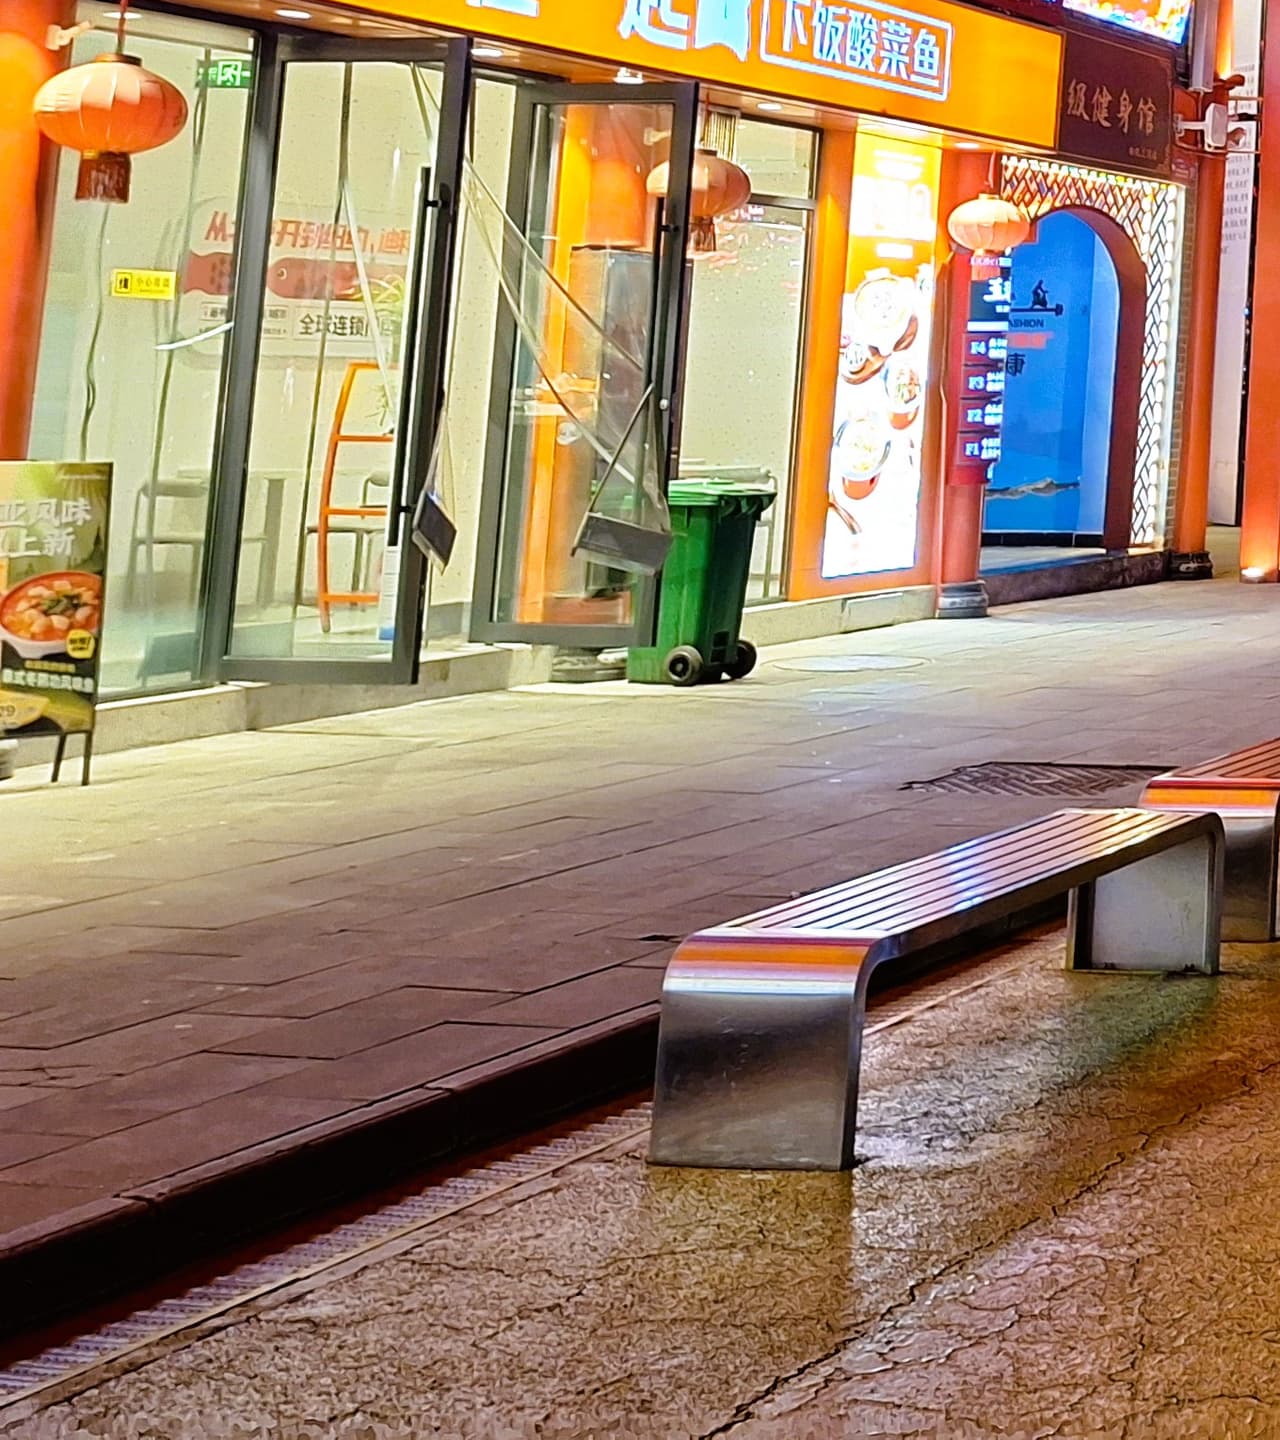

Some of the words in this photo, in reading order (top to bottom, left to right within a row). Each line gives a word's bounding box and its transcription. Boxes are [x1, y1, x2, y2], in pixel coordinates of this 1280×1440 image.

[1067, 78, 1157, 136] 级健身馆
[964, 442, 980, 456] F1
[0, 526, 77, 559] 上新
